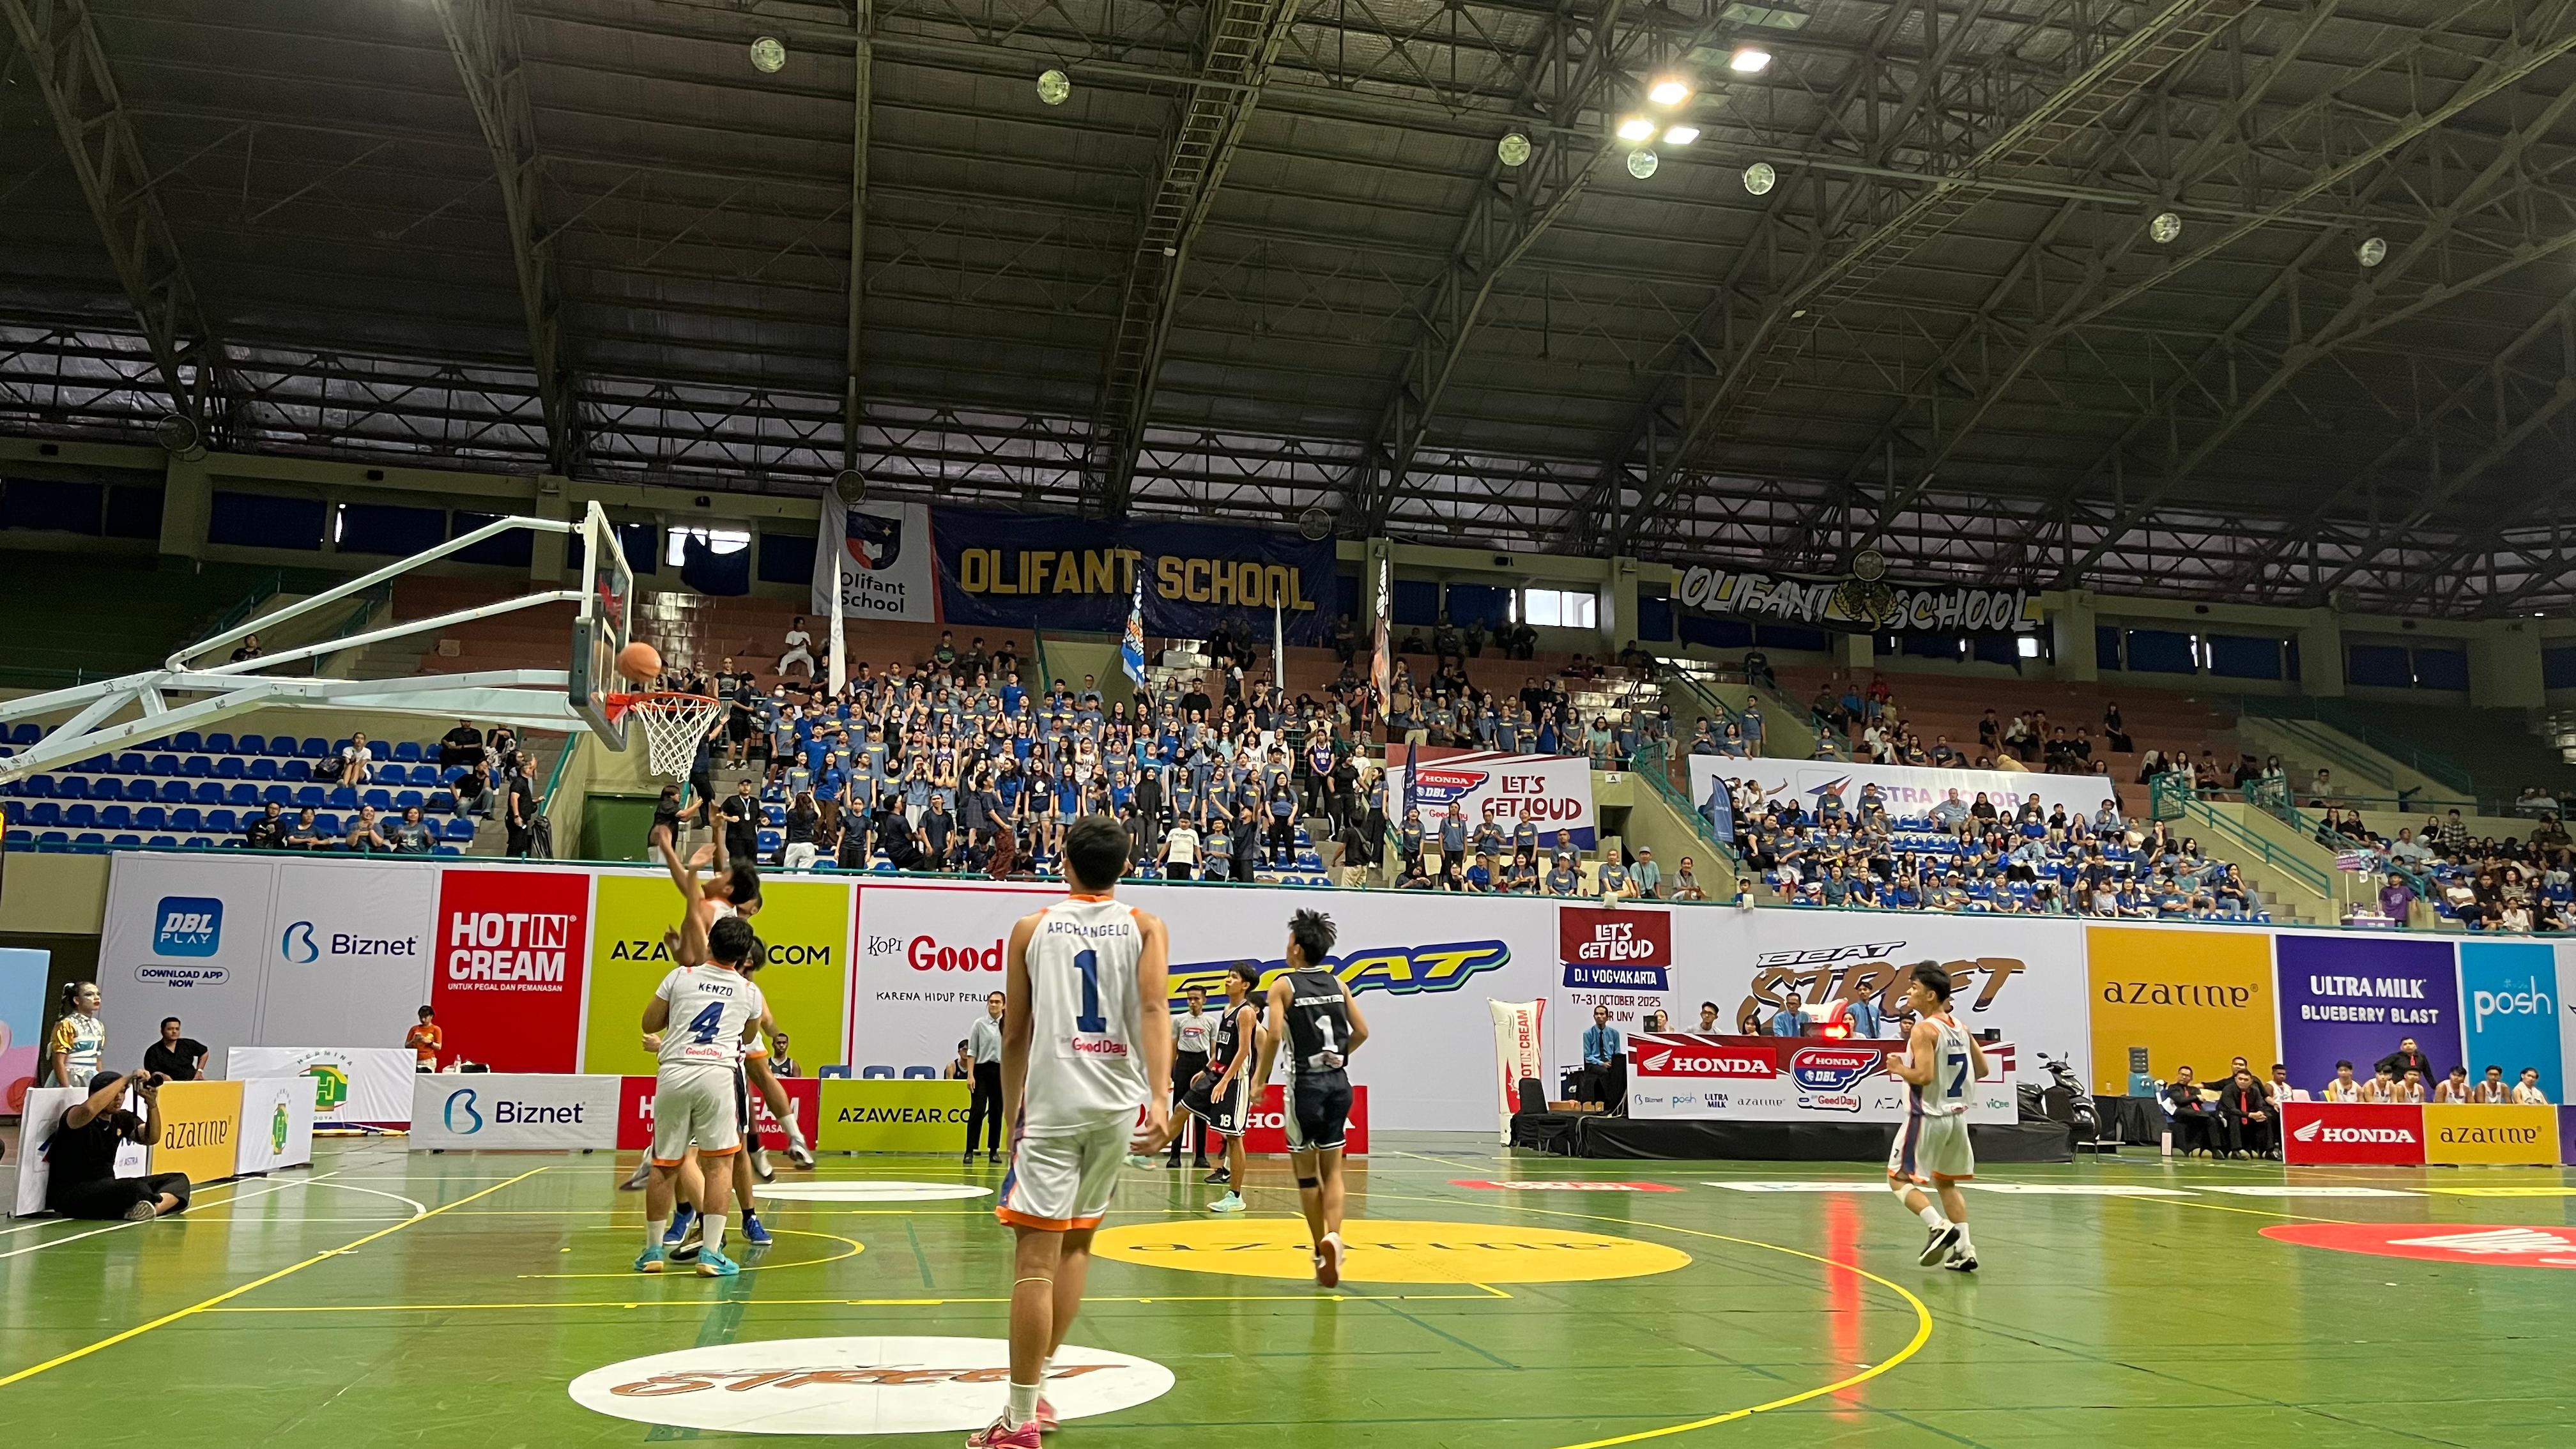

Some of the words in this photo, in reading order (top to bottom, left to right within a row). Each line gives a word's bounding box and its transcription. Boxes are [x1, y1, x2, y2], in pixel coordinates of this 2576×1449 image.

[841, 572, 905, 595] Olifant
[961, 548, 1141, 594] OLIFANT
[1157, 555, 1315, 611] SCHOOL
[841, 590, 904, 613] School
[1680, 565, 1838, 622] OLIFANT
[1883, 587, 2038, 632] SCHOOL
[1425, 774, 1469, 785] HONDA
[1501, 774, 1545, 794] LET'S
[1425, 786, 1448, 799] DBL
[1940, 788, 2022, 808] OOR
[1482, 797, 1523, 818] GET
[1524, 797, 1582, 822] LOUD
[162, 912, 213, 933] DBL
[1047, 922, 1129, 938] ARCHANGELO
[160, 933, 211, 944] PLAY
[1595, 923, 1634, 942] LET'S
[331, 933, 417, 956] Biznet
[908, 935, 1004, 972] Good
[1579, 942, 1611, 959] GET
[1609, 939, 1654, 961] LOUD
[142, 969, 200, 979] DOWNLOAD
[449, 949, 565, 982] CREAM
[169, 979, 194, 988] NOW
[1574, 969, 1588, 982] D.I
[1591, 969, 1657, 985] YOGYAKARTA
[698, 982, 733, 997] KENZO
[1073, 949, 1107, 1032] 1
[2104, 981, 2250, 1008] azarine
[2310, 975, 2373, 997] ULTRA
[2375, 977, 2425, 999] MILK
[876, 992, 921, 1002] KARENA
[924, 992, 955, 1002] HIDUP
[959, 992, 990, 1002] PERLU
[1572, 993, 1597, 1005] 17-31
[1599, 995, 1635, 1006] OCTOBER
[1637, 996, 1661, 1007] 2025
[2473, 975, 2551, 1033] posh
[687, 1001, 725, 1044] 4
[1616, 1011, 1634, 1022] UNY
[2301, 1004, 2385, 1022] BLUEBERRY
[2391, 1008, 2439, 1024] BLAST
[1315, 1015, 1338, 1053] 1
[1516, 1010, 1530, 1048] CREAM
[1072, 1037, 1101, 1053] Good
[1102, 1039, 1128, 1057] Day
[1521, 1062, 1531, 1078] OT
[1673, 1057, 1771, 1073] HONDA
[1815, 1057, 1859, 1066] HONDA
[1814, 1070, 1837, 1082] DBL
[1947, 1053, 1968, 1098] 7
[1672, 1092, 1697, 1108] posh
[1705, 1093, 1729, 1101] ULTRA
[1737, 1098, 1783, 1107] azarine
[1818, 1096, 1839, 1105] Good
[1841, 1096, 1857, 1107] Day
[495, 1101, 584, 1124] Biznet
[838, 1107, 990, 1123] AZAWEAR.CO
[1220, 1114, 1232, 1127] 18
[165, 1119, 228, 1150] azarine
[2322, 1127, 2416, 1144] HONDA
[2440, 1126, 2537, 1144] azarine
